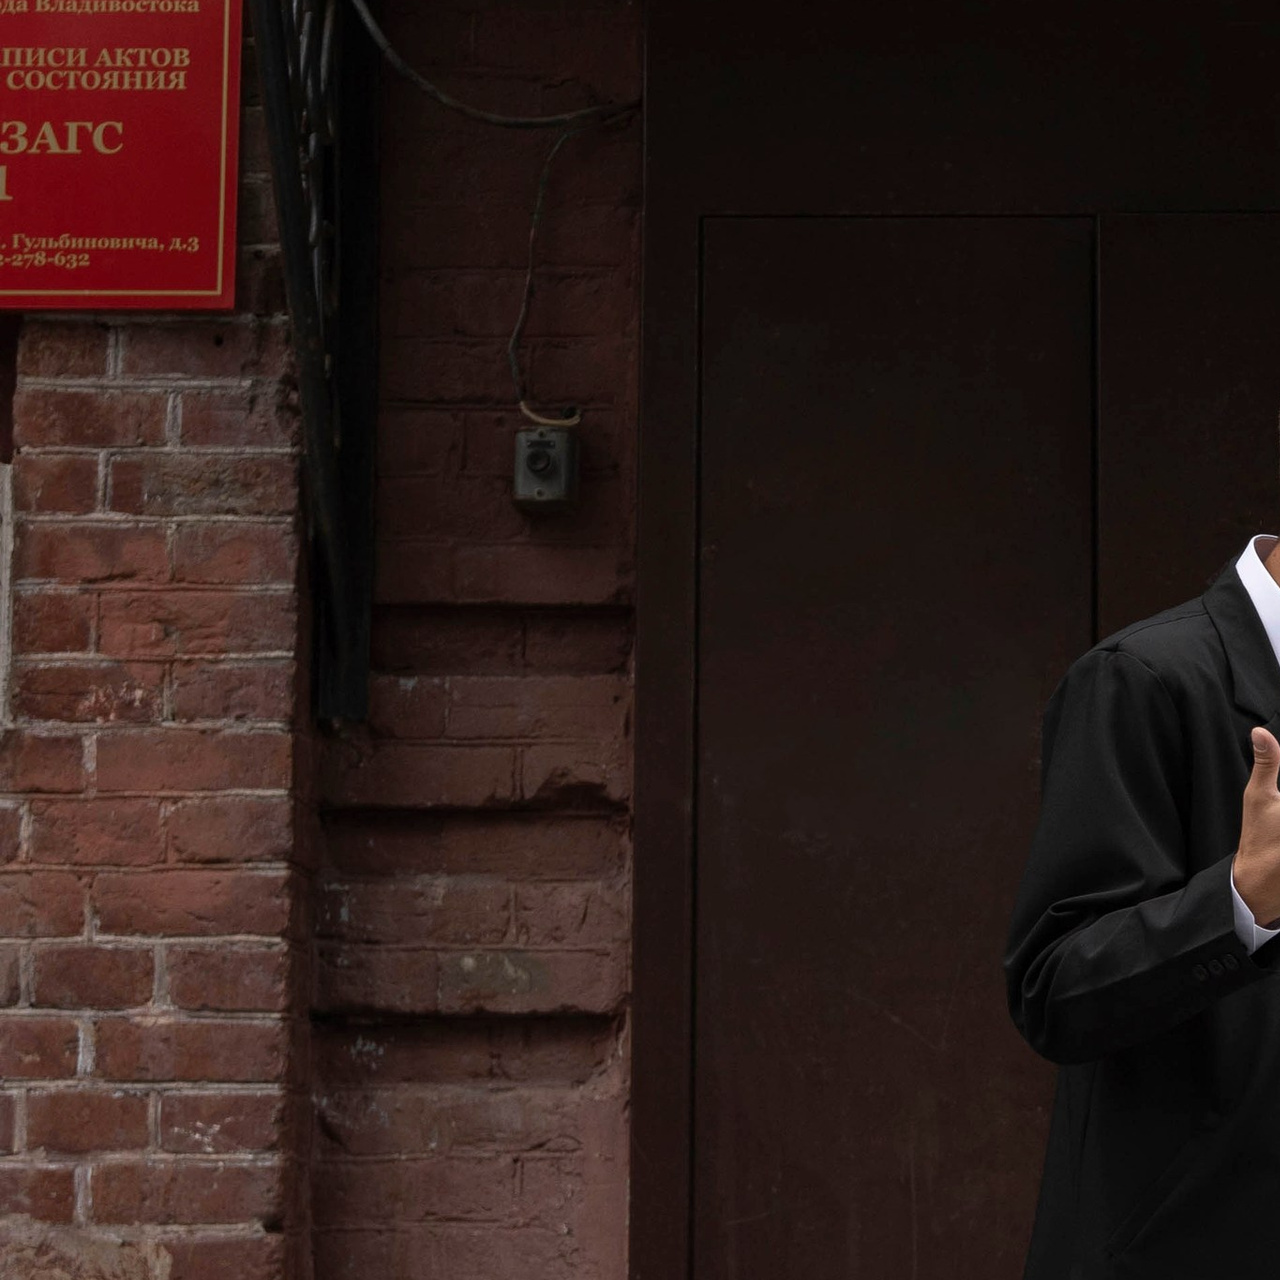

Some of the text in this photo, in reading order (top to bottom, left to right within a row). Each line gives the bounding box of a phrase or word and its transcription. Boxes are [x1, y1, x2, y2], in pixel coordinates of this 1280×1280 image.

[0, 47, 191, 67] ПИСИ АКТОВ
[7, 70, 187, 91] СОСТОЯНИЯ
[0, 121, 124, 154] ЗАГС
[12, 233, 165, 253] Гульбиновича,
[169, 236, 199, 253] д.3
